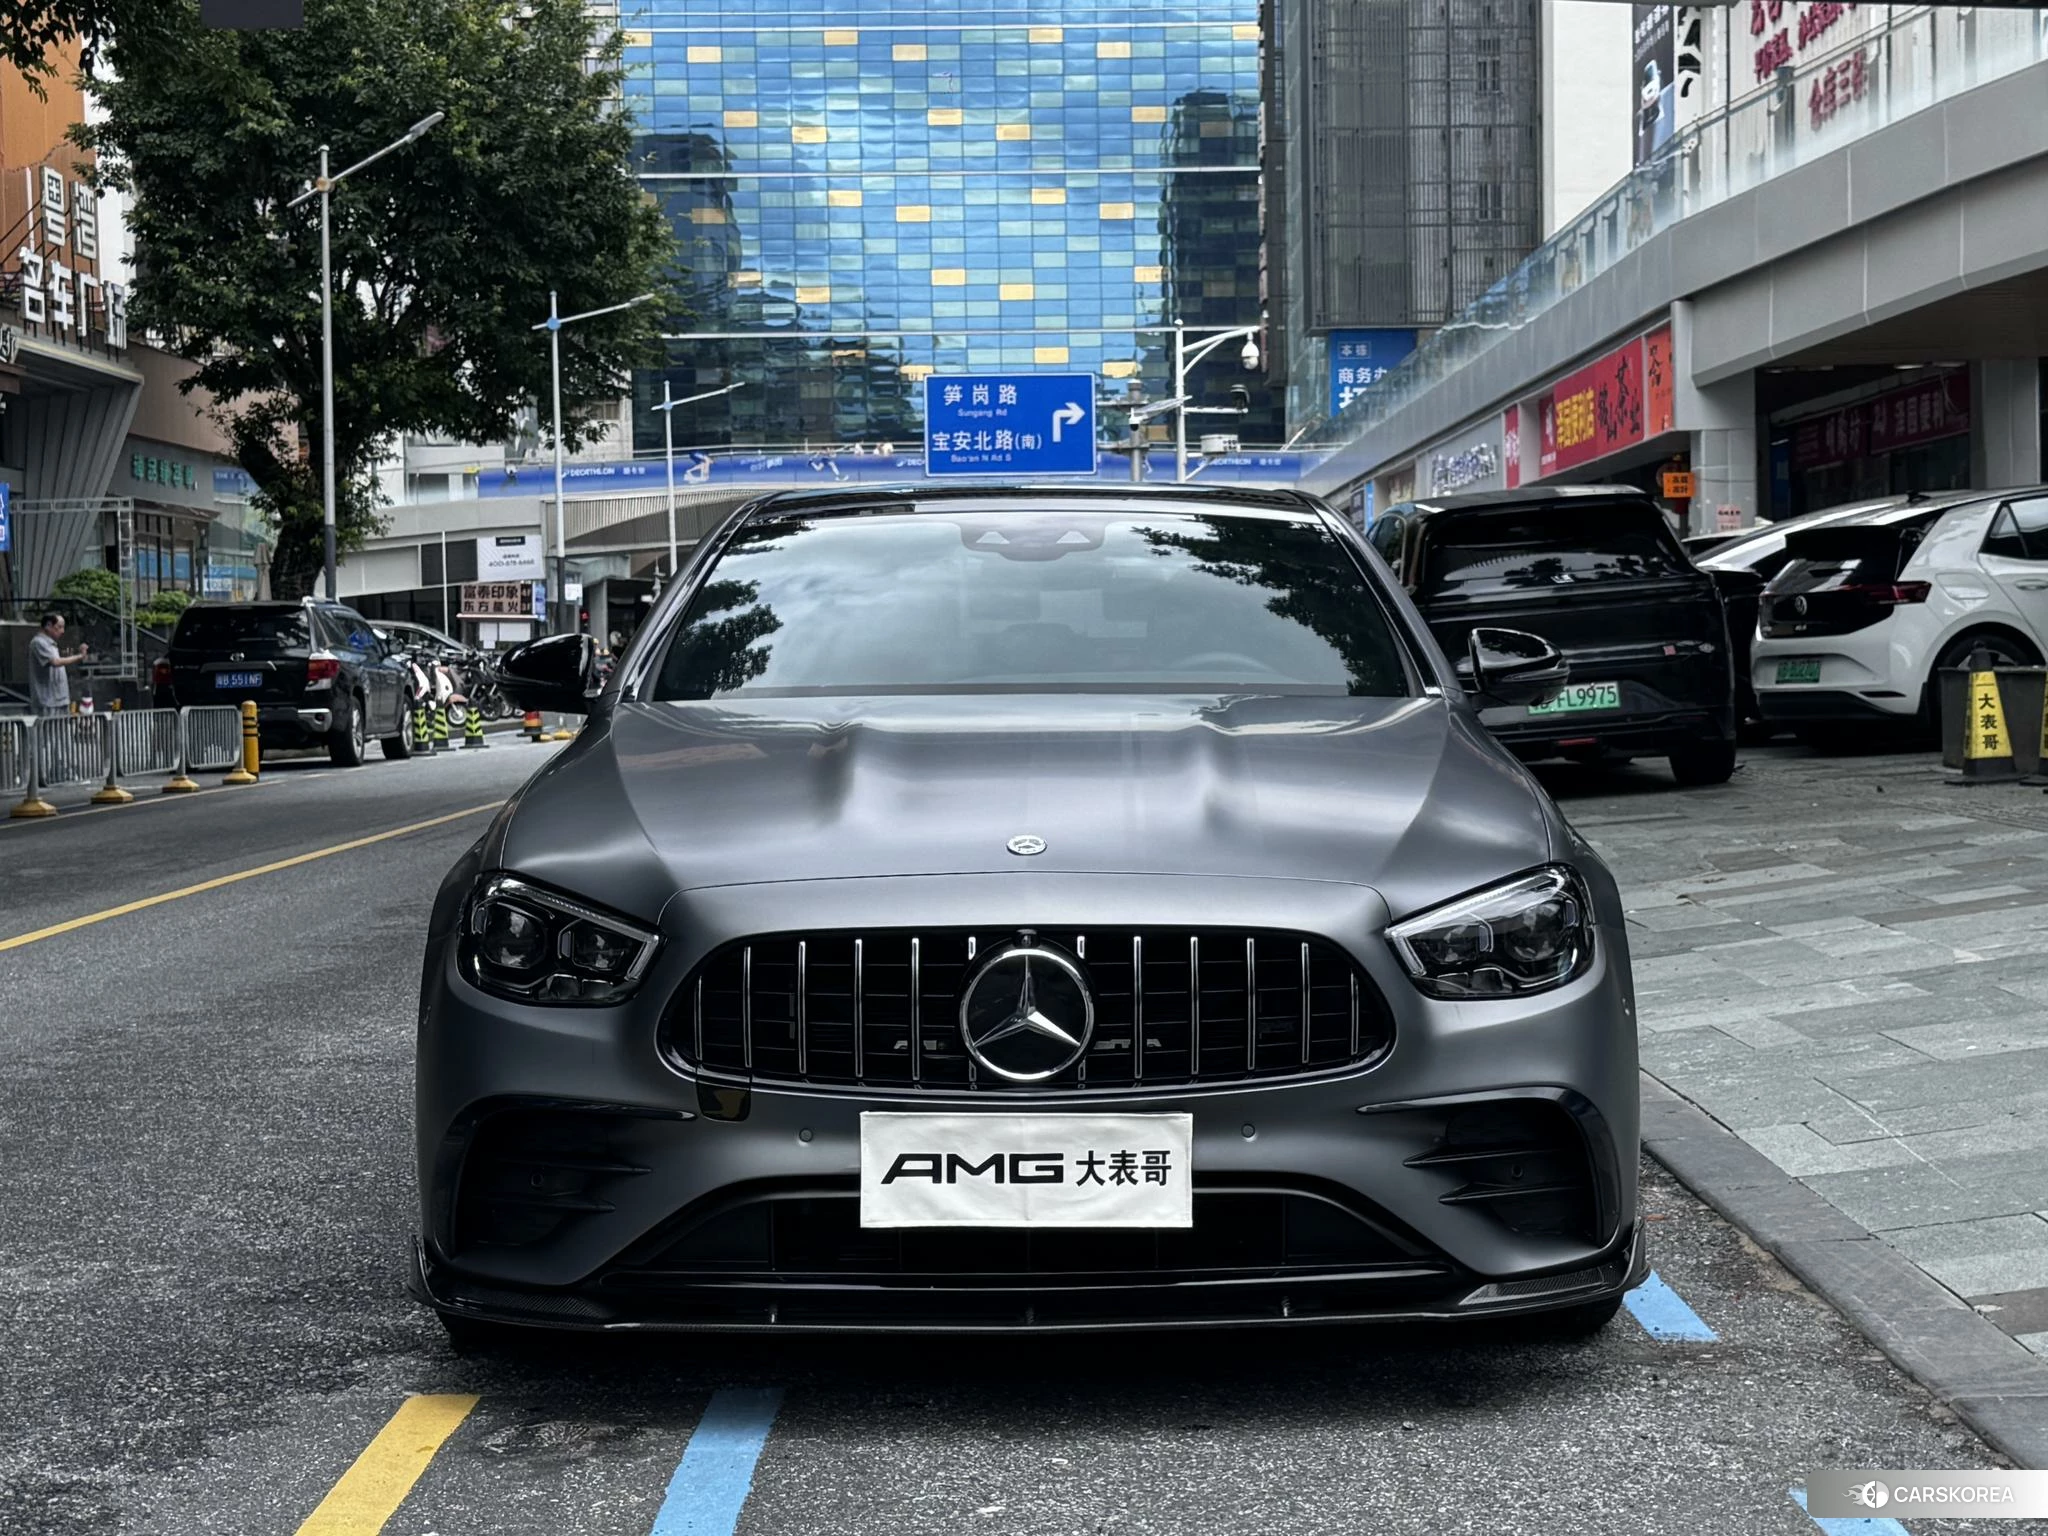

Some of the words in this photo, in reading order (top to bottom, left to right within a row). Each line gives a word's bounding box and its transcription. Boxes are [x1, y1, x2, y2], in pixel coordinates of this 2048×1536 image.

[943, 384, 1017, 406] 笋岗路
[957, 408, 993, 418] Sungang
[995, 408, 1008, 417] Rd
[981, 454, 989, 462] N
[990, 454, 1003, 462] Rd
[570, 467, 615, 477] DECATHLON
[1978, 693, 1999, 750] 大表哥
[880, 1153, 1064, 1184] AMG
[1075, 1150, 1172, 1186] 大表哥
